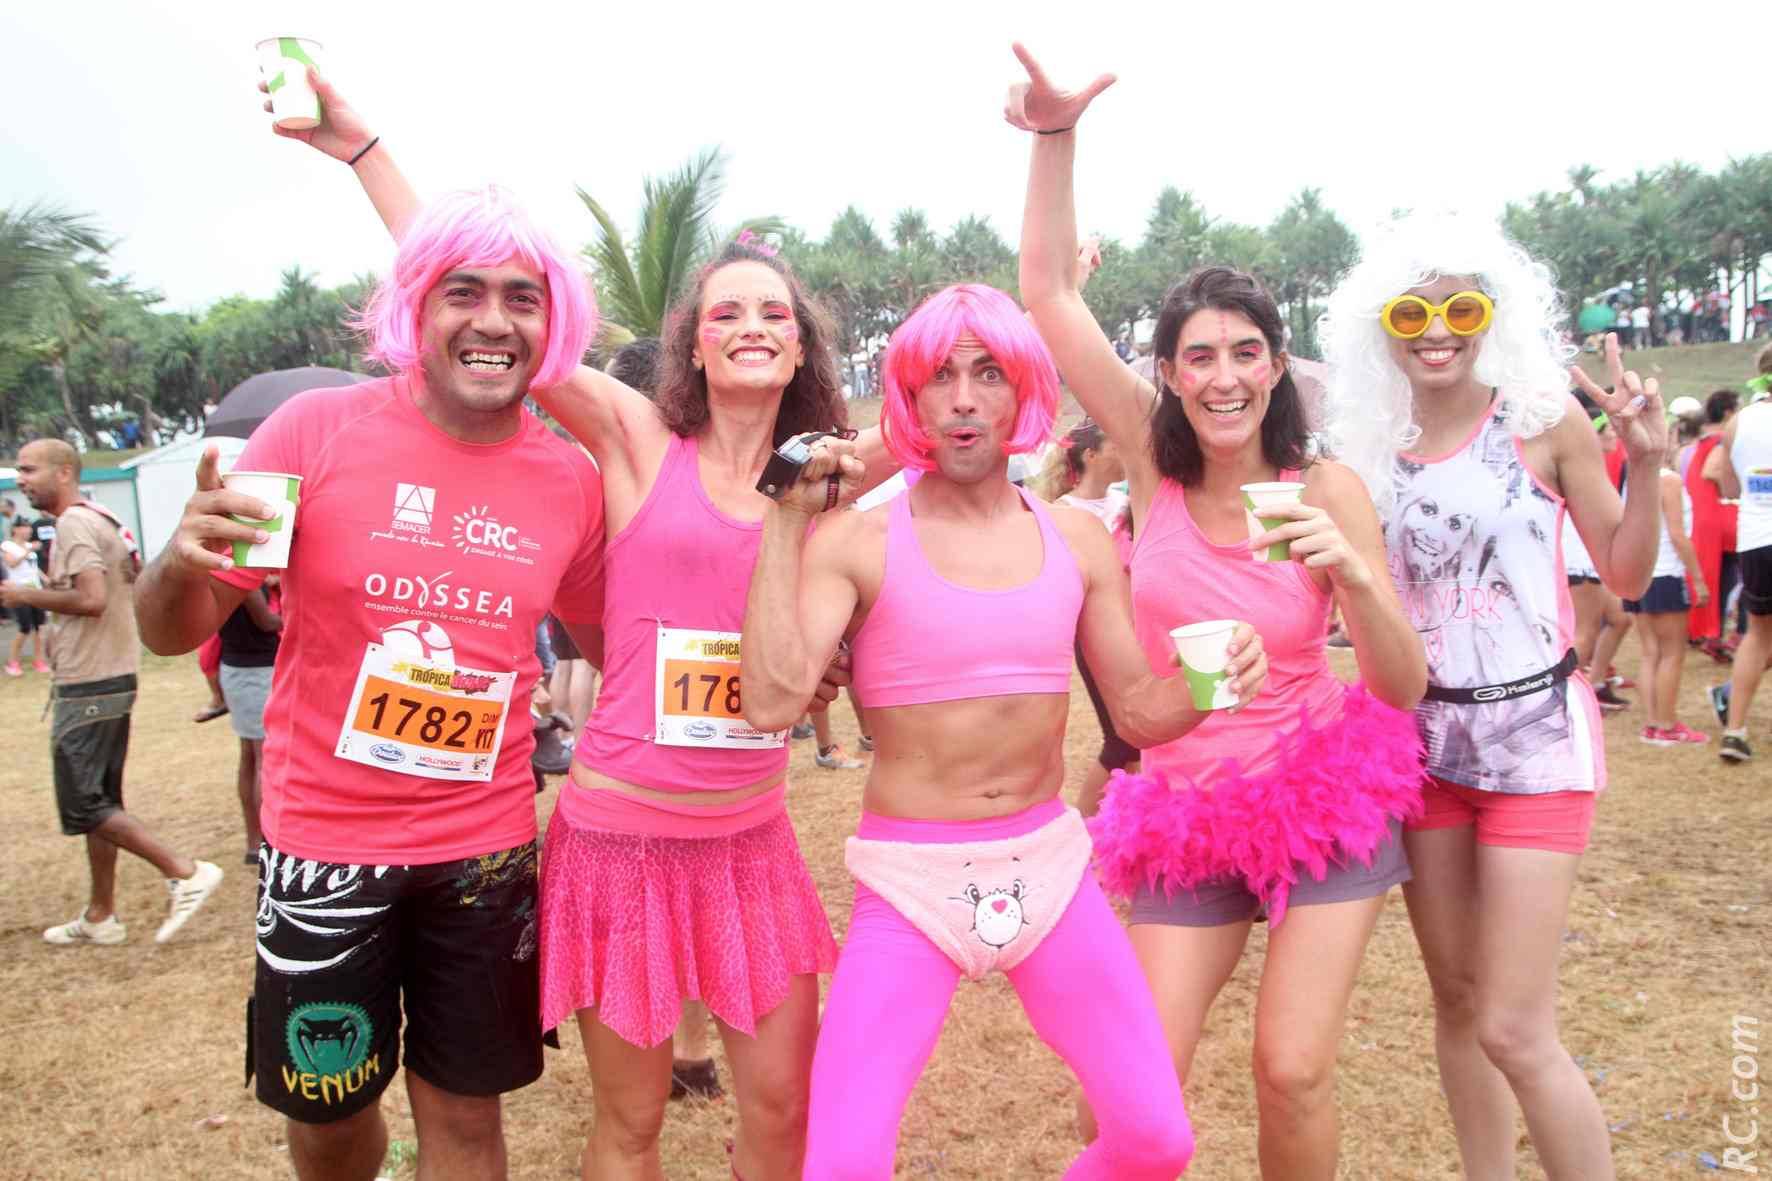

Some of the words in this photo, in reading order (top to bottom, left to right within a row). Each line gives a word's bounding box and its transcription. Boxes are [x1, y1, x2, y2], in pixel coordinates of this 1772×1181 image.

[466, 518, 519, 551] CRC
[364, 570, 513, 619] ODYSSEA
[364, 600, 409, 616] ensemble
[410, 608, 439, 618] contre
[369, 692, 473, 748] 1782
[281, 1053, 380, 1105] VENUM
